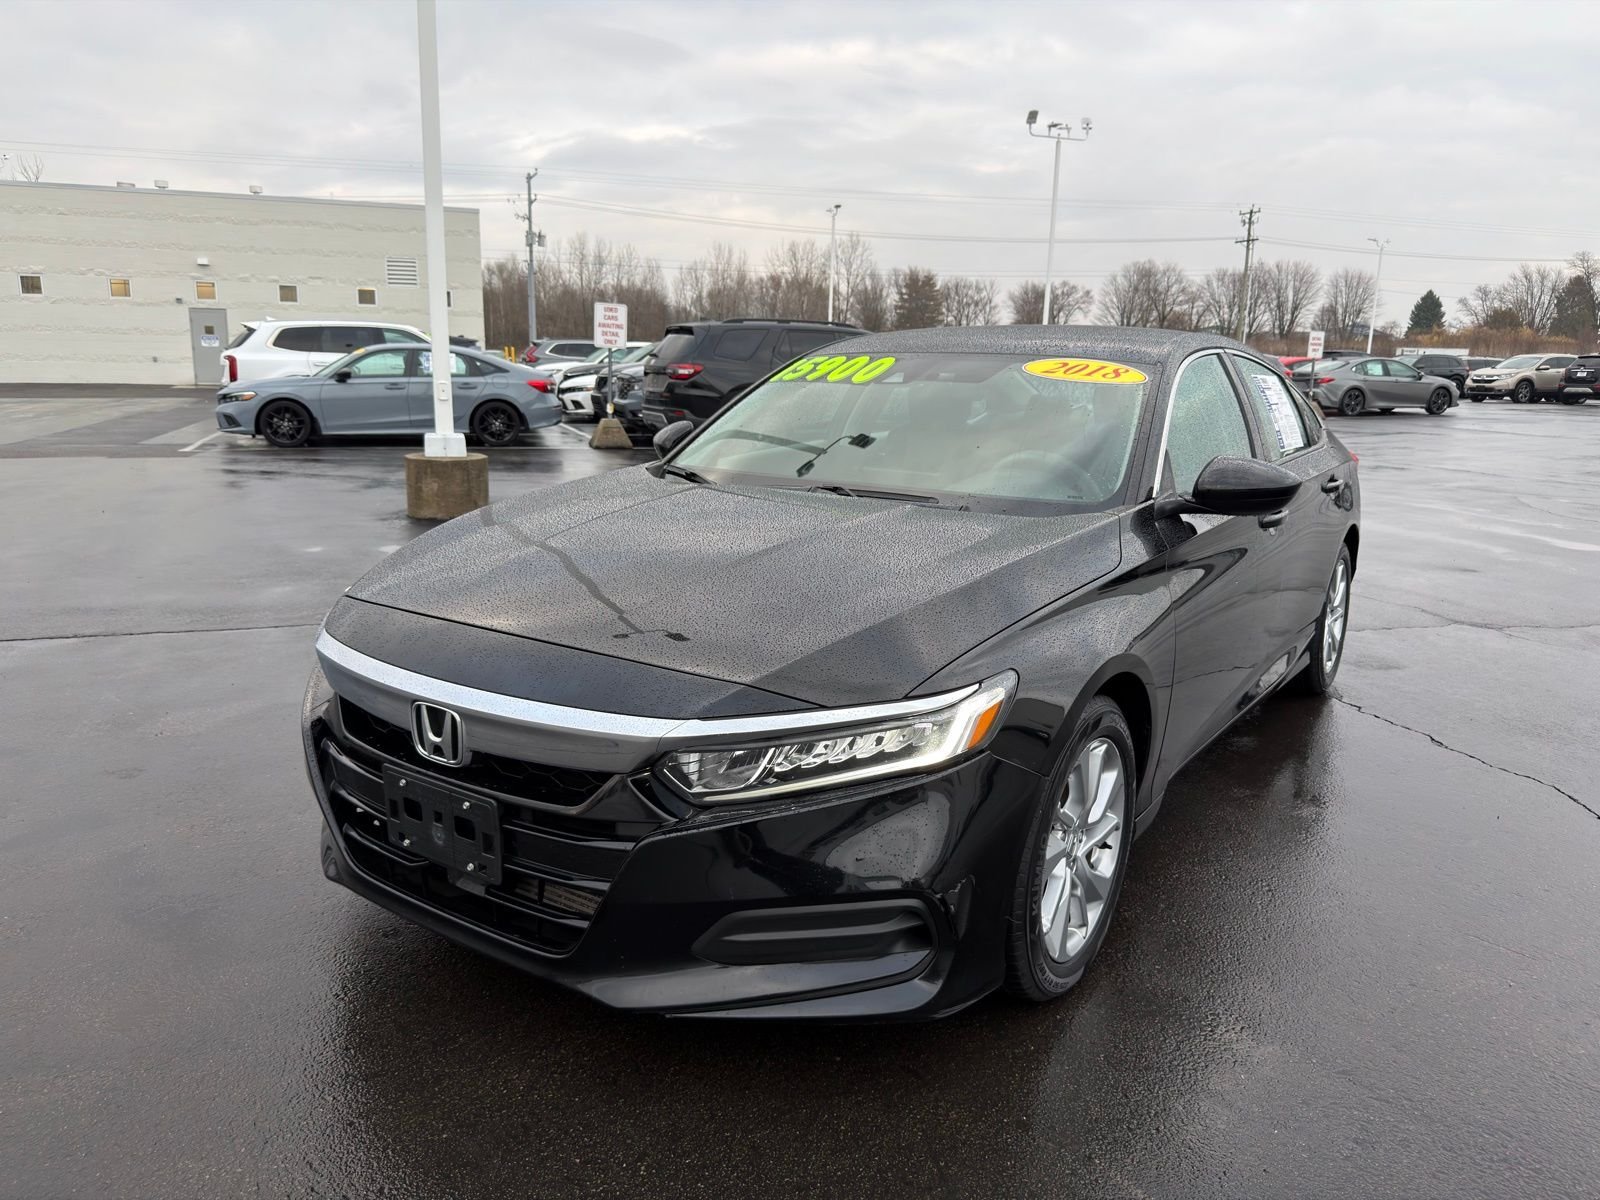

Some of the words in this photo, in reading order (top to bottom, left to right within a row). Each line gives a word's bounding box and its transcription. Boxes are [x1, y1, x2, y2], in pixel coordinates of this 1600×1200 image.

[598, 322, 624, 330] AWAITING
[602, 330, 620, 338] DETAIL
[769, 355, 896, 384] 15900
[1041, 362, 1130, 379] 2018
